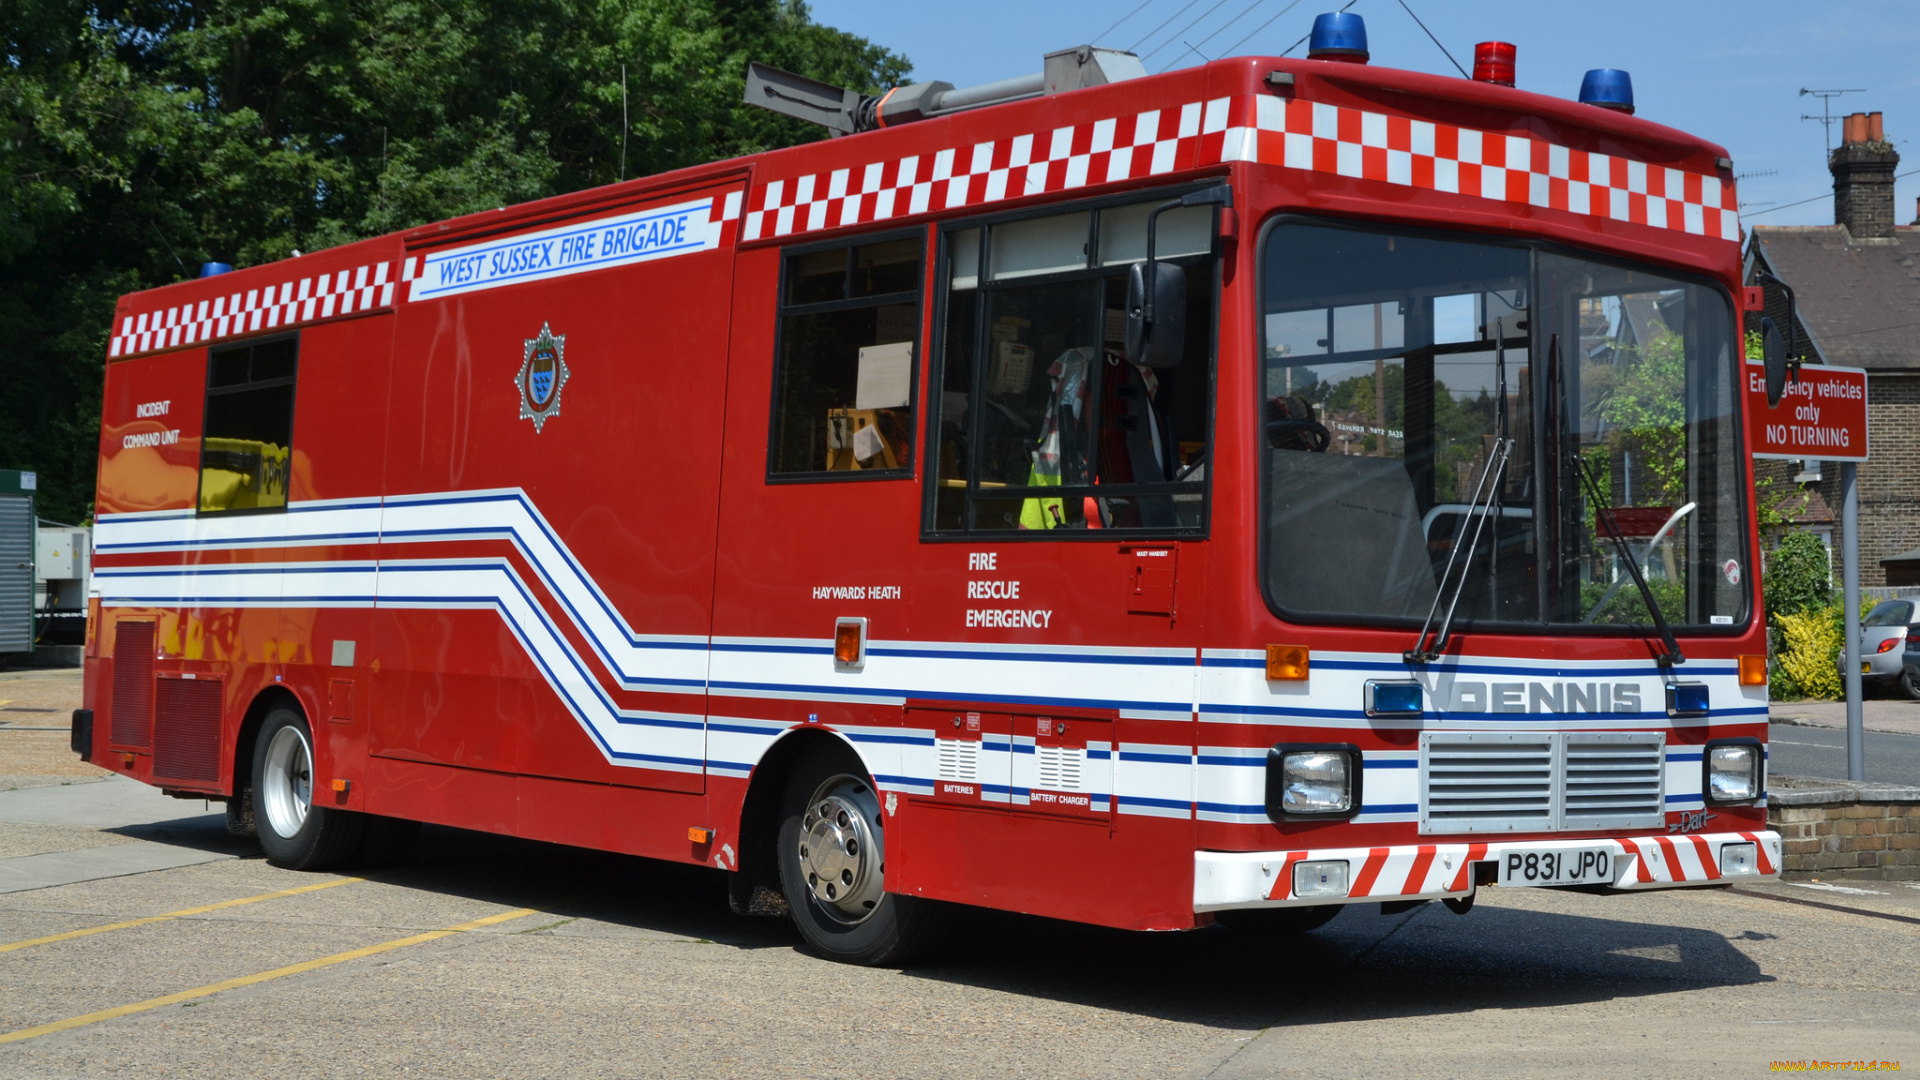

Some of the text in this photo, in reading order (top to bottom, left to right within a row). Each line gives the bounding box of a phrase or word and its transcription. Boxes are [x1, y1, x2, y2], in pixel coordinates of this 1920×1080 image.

[440, 215, 688, 285] WEST SUSSEX FIRE BRIGADE
[1817, 379, 1862, 400] vehicles
[136, 400, 171, 418] INCIDENT
[1795, 402, 1820, 424] only
[123, 429, 180, 449] COMMAND UNIT
[1766, 425, 1849, 447] NO TURNING
[969, 552, 997, 571] FIRE
[812, 586, 901, 600] HAYWARDS HEATH
[967, 581, 1020, 599] RESCUE
[966, 609, 1052, 629] EMERGENCY
[1449, 682, 1641, 714] DENNIS
[943, 784, 974, 796] BATTERIES
[1030, 792, 1089, 807] BATTERY CHARGER
[1678, 808, 1716, 833] Dart
[1507, 853, 1562, 881] P831
